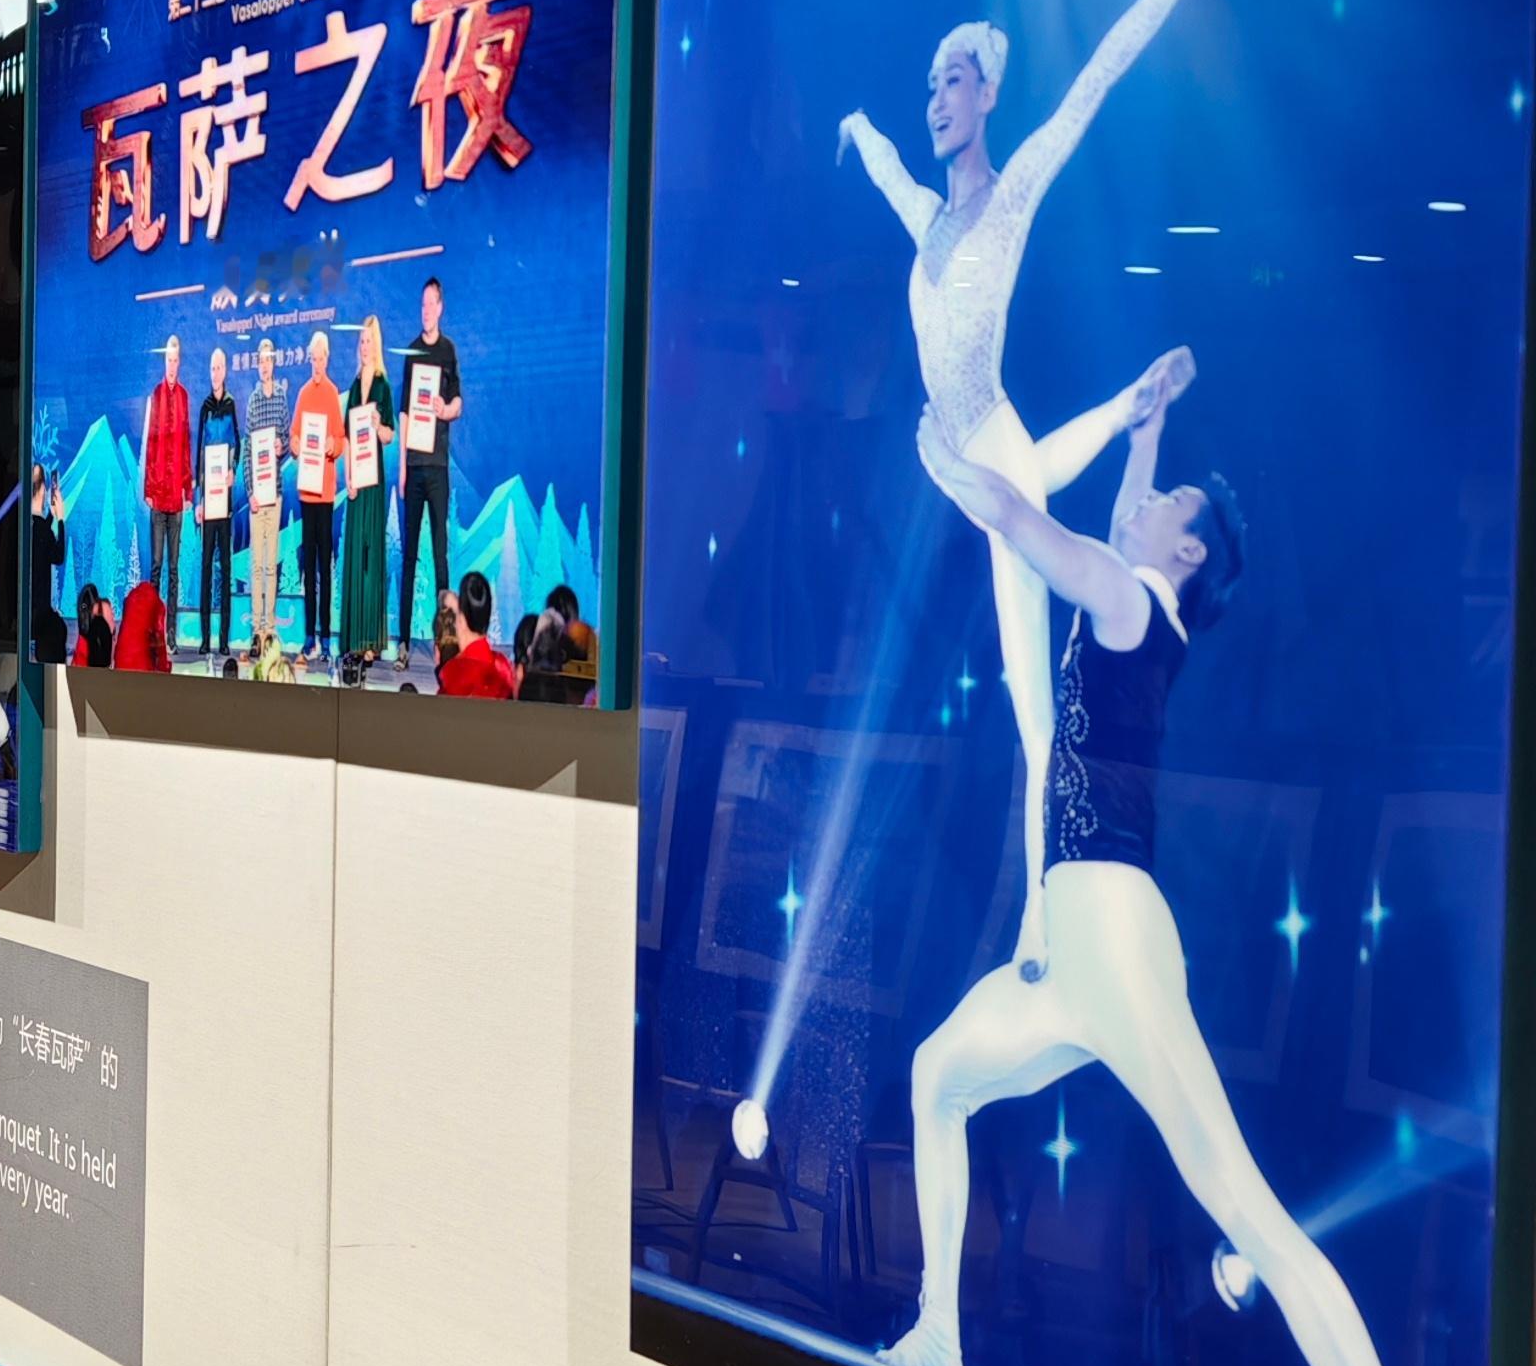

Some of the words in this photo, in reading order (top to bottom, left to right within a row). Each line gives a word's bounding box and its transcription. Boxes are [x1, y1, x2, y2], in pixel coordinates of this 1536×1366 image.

[49, 1126, 61, 1165] It
[64, 1133, 77, 1171] is
[81, 1138, 117, 1190] held
[34, 1177, 71, 1219] year.
